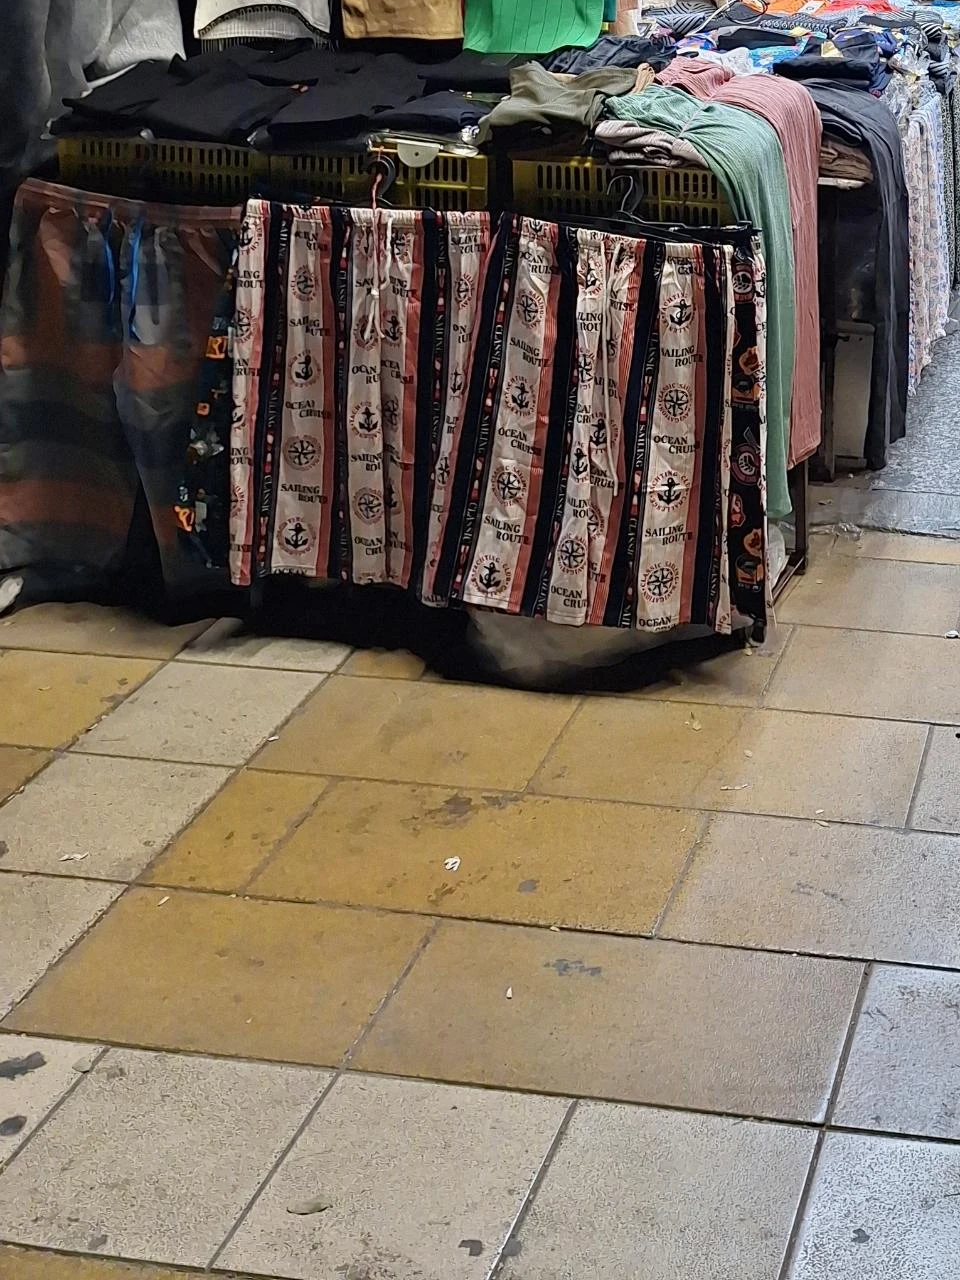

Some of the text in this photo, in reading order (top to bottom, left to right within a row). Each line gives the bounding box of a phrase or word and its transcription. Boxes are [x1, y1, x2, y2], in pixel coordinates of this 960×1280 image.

[510, 337, 540, 357] SAILING
[498, 427, 528, 442] OCEAN
[653, 435, 688, 446] OCEAN
[511, 439, 542, 457] CRUISE
[635, 424, 647, 468] SAILING
[462, 502, 477, 541] CLASSIC
[484, 516, 521, 533] SAILING
[496, 531, 530, 545] ROUTE
[645, 524, 684, 538] SAILING
[661, 531, 694, 546] ROUTE
[551, 585, 582, 598] OCEAN
[639, 616, 672, 627] OCEAN
